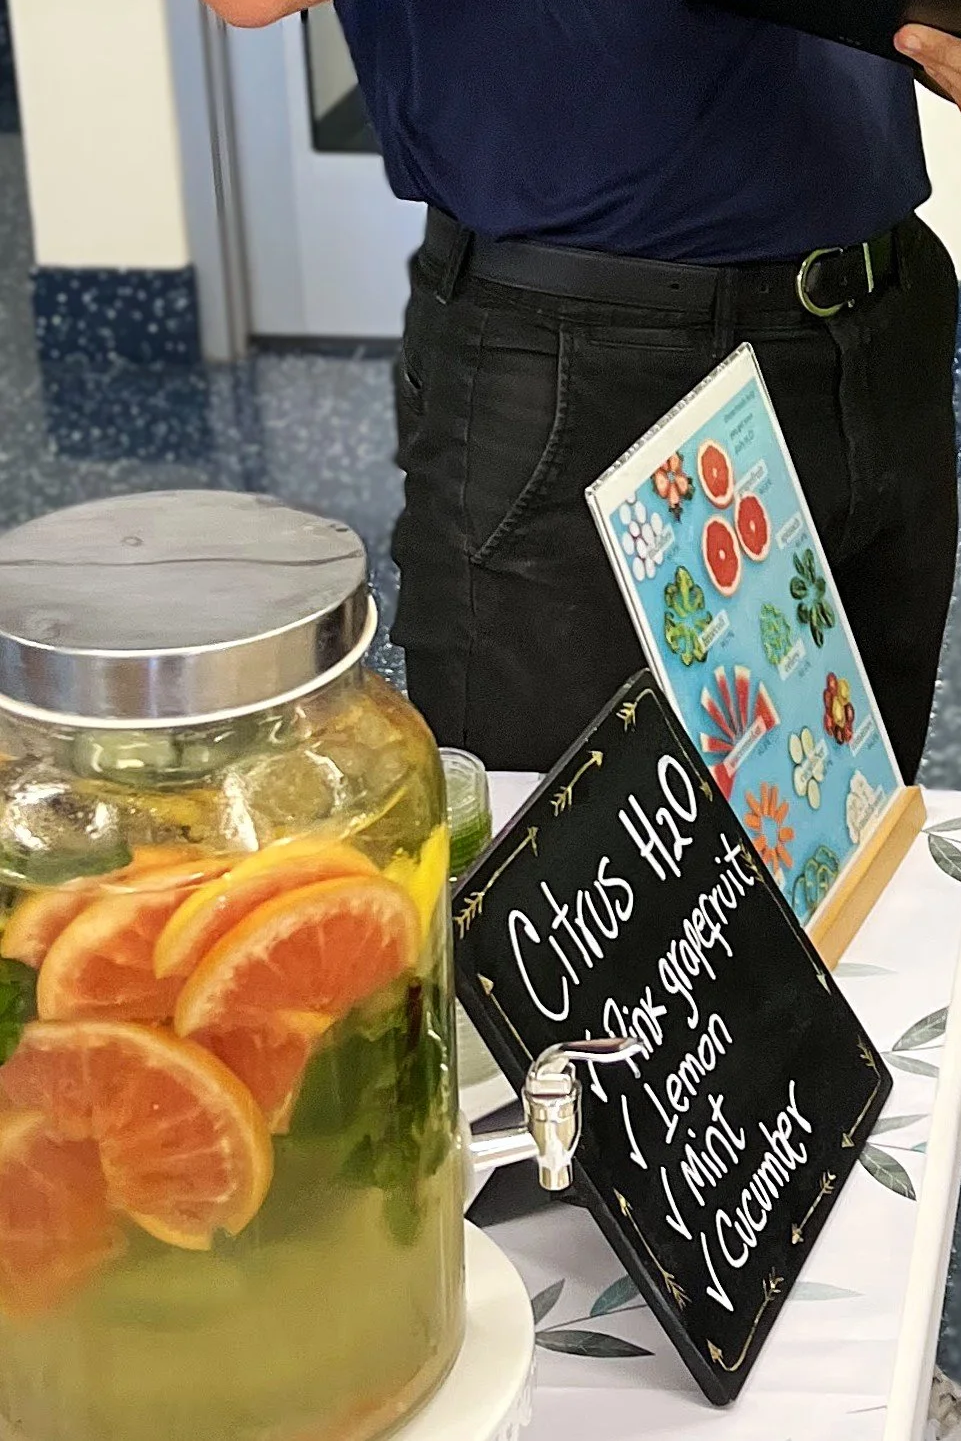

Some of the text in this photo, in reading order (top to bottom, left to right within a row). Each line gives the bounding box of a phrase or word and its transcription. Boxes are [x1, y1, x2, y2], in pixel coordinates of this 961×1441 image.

[508, 754, 697, 1022] Citrus H2O
[603, 833, 755, 1079] Pink grapefruit
[644, 1013, 733, 1144] Lemon
[681, 1094, 746, 1206] Mint
[715, 1080, 812, 1269] Cucumber
